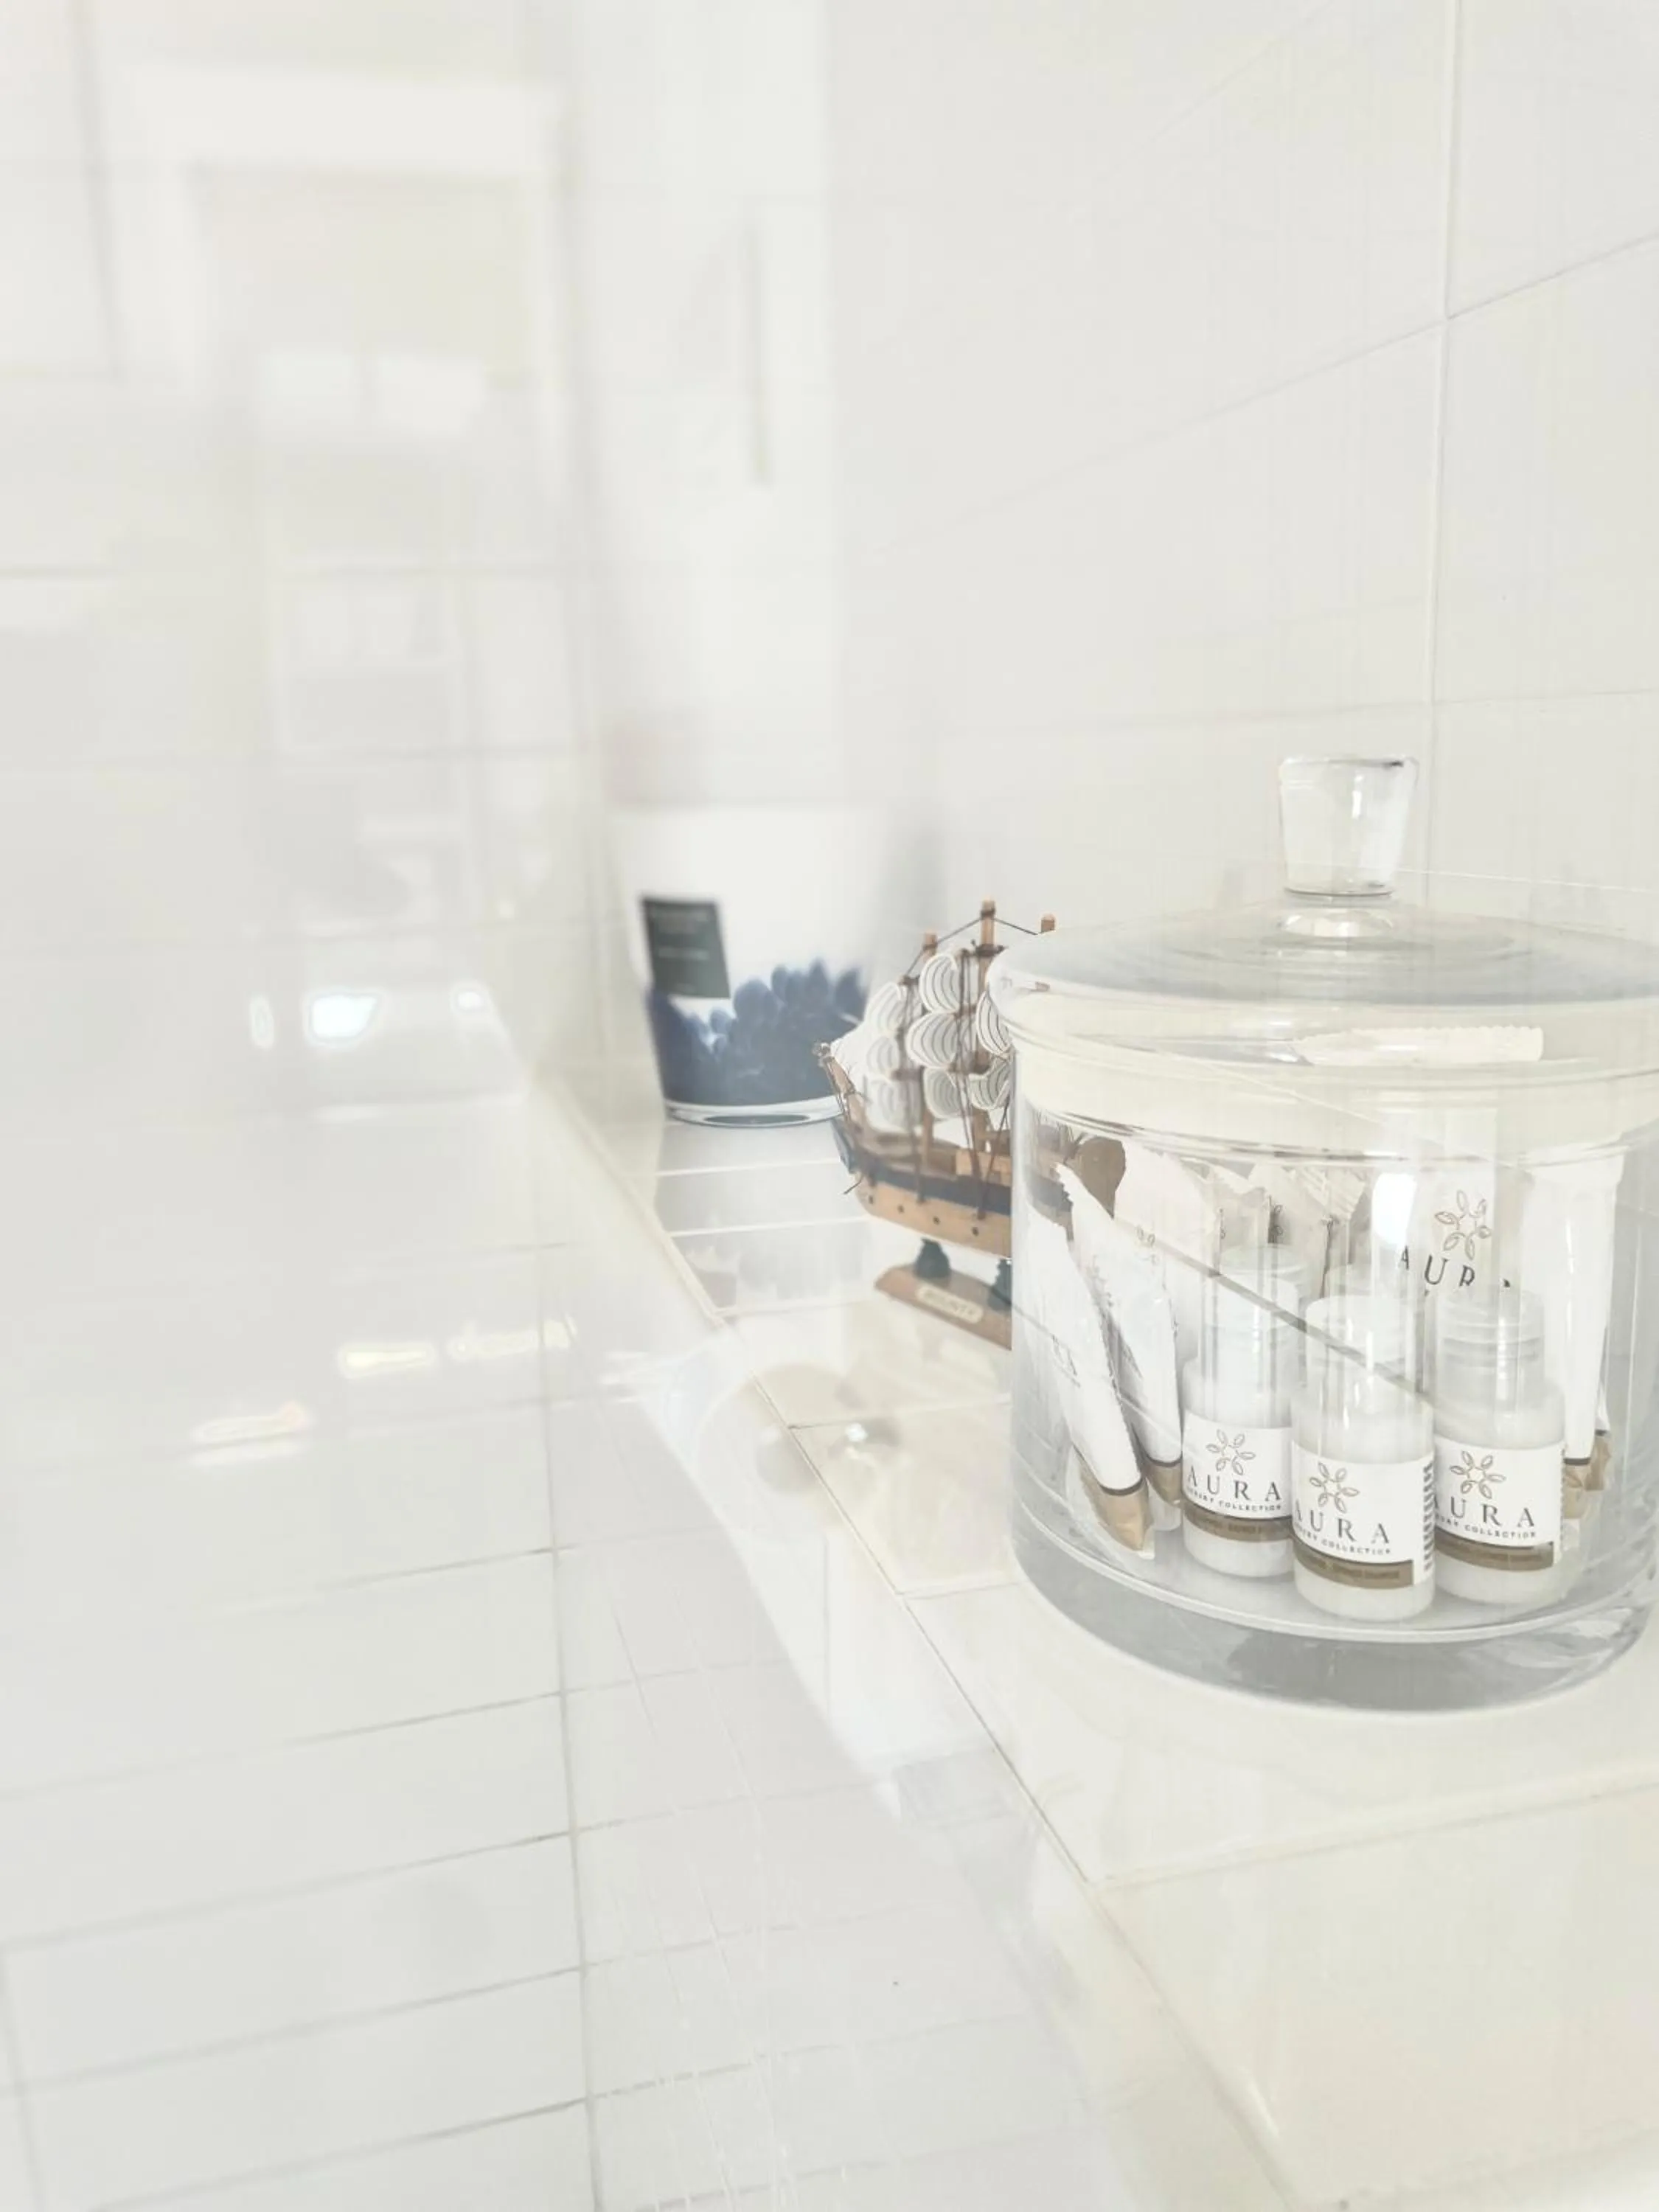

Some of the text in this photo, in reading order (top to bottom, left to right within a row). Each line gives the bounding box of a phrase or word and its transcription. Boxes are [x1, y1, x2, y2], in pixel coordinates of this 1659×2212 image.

[1399, 1245, 1511, 1287] AUR
[1186, 1464, 1282, 1503] AURA
[1186, 1484, 1281, 1511] XURY COLLECTION
[1294, 1498, 1390, 1544] AURA
[1294, 1521, 1318, 1541] URY
[1321, 1538, 1391, 1556] COLLECTION
[1464, 1524, 1536, 1540] COLLECTION
